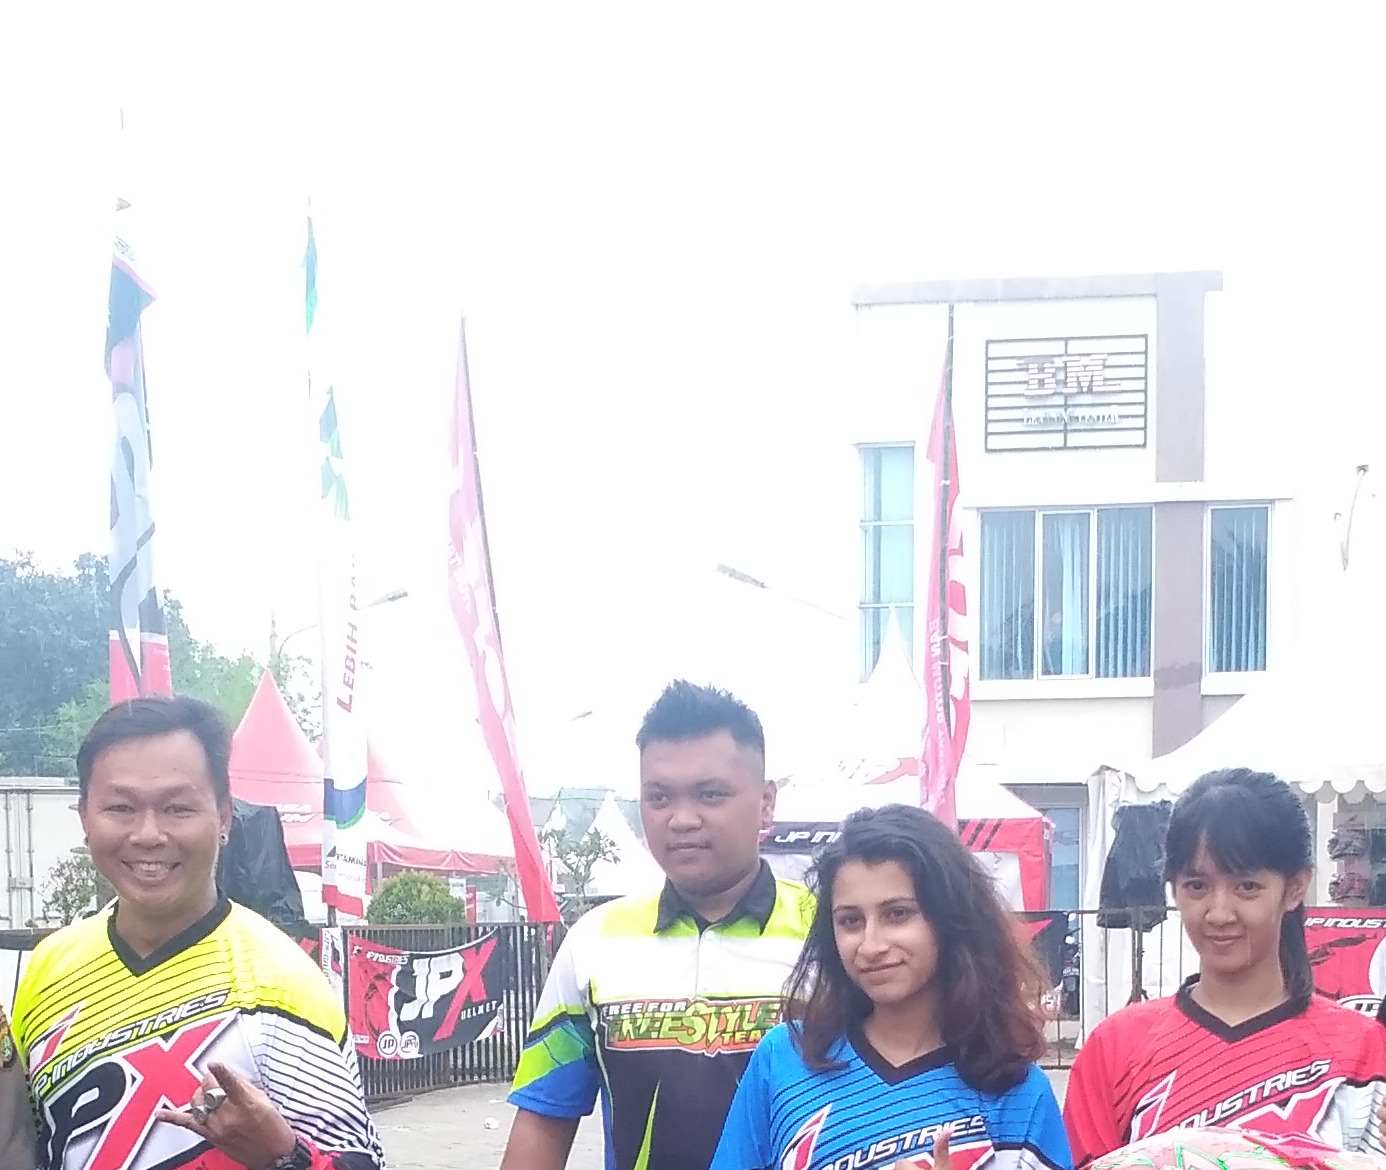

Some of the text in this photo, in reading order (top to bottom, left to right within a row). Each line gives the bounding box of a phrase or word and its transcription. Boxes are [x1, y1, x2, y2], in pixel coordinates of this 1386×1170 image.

[399, 937, 499, 1041] JPX
[647, 1001, 686, 1013] FOR
[721, 1030, 764, 1046] TEA
